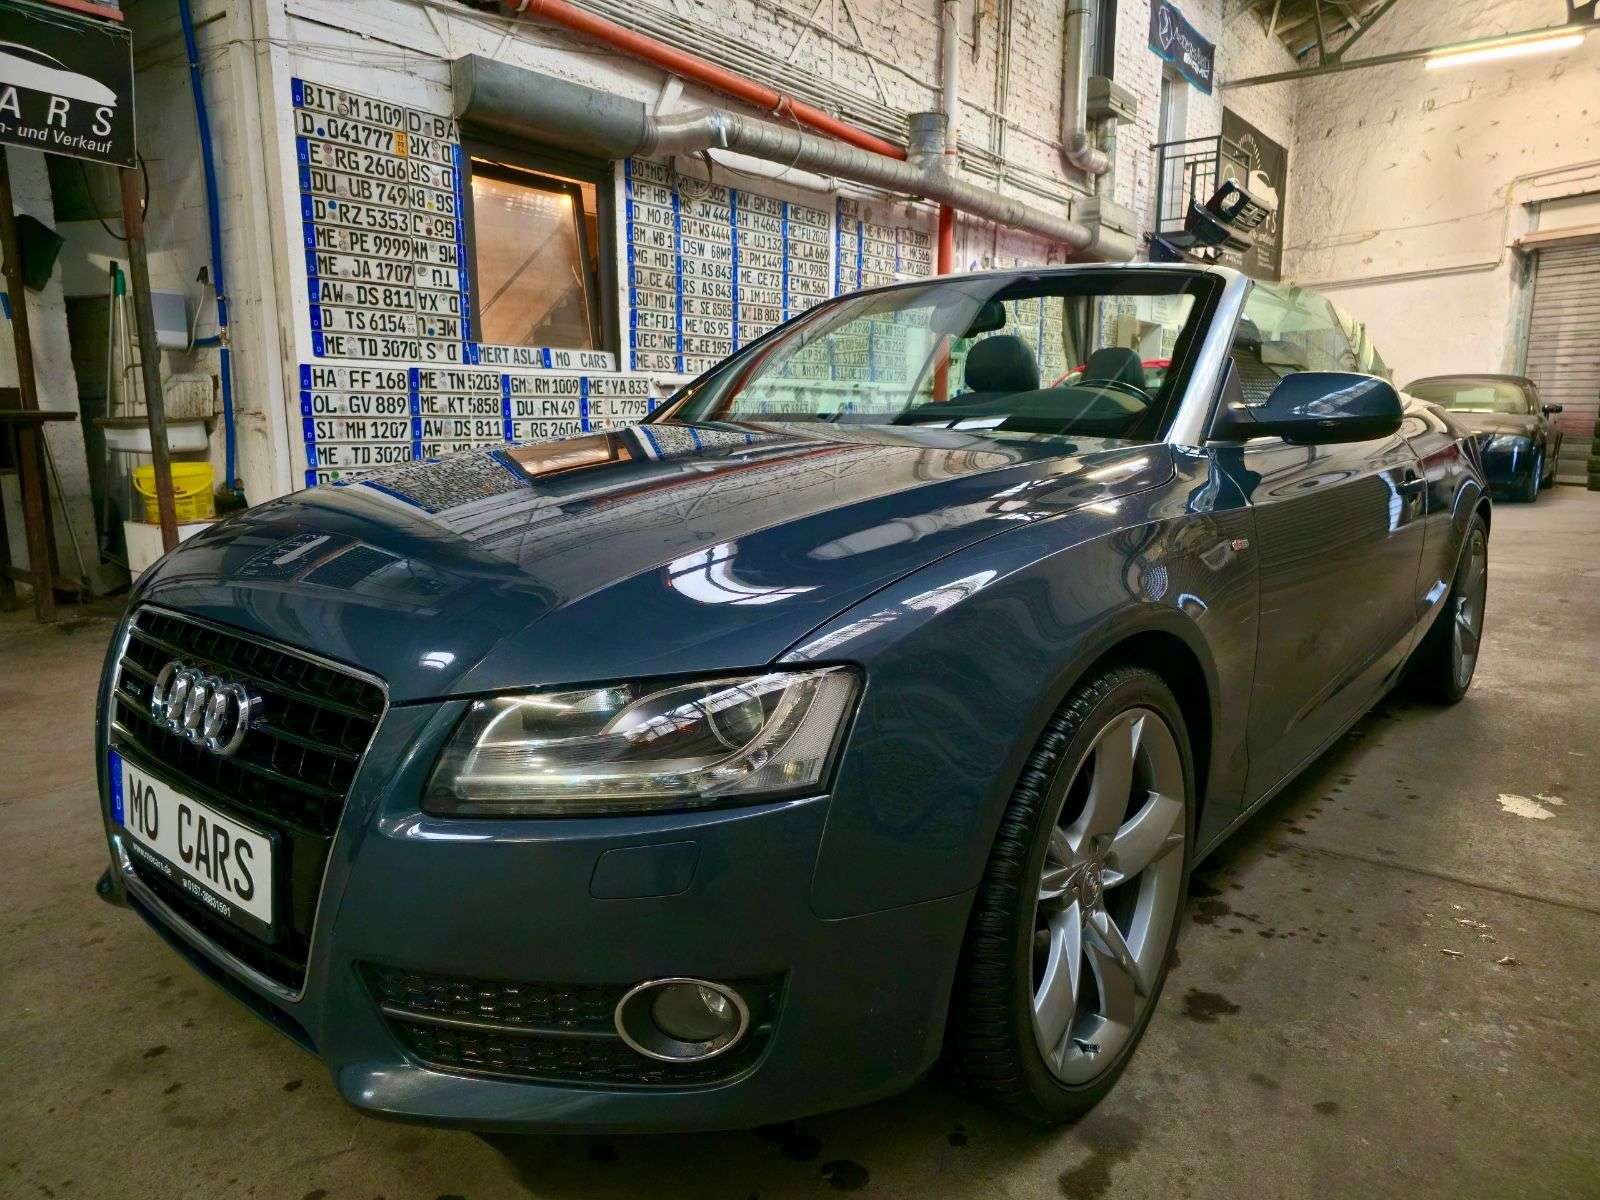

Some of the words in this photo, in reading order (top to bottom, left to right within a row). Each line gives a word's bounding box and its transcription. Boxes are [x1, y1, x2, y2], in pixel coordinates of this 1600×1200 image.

[304, 85, 336, 111] BIT
[349, 97, 360, 117] M
[364, 101, 402, 127] 1109
[19, 125, 47, 141] und
[54, 129, 112, 153] Verkauf
[303, 112, 314, 134] D
[327, 119, 393, 151] 041777
[309, 142, 322, 164] E
[335, 149, 359, 171] RG
[364, 155, 406, 179] 2606
[312, 171, 336, 194] DU
[350, 179, 372, 202] UB
[376, 183, 409, 204] 749
[315, 199, 326, 219] D
[339, 204, 362, 225] RZ
[366, 208, 408, 232] 5353
[634, 204, 640, 219] D
[647, 208, 660, 223] MO
[682, 220, 692, 234] GV
[316, 227, 337, 248] ME
[349, 232, 370, 252] PE
[374, 235, 410, 258] 9999
[634, 227, 645, 243] BM
[653, 231, 664, 249] WB
[738, 232, 748, 246] ME
[634, 249, 647, 264] MG
[655, 252, 668, 267] HD
[318, 255, 338, 276] ME
[352, 259, 371, 279] JA
[376, 262, 413, 283] 1707
[683, 261, 695, 275] RS
[701, 263, 713, 278] AS
[716, 264, 732, 279] 843
[636, 270, 642, 284] D
[650, 273, 662, 287] CE
[741, 271, 752, 283] ME
[758, 272, 768, 286] CE
[770, 274, 779, 287] 73
[321, 282, 343, 302] AW
[356, 286, 379, 306] DS
[383, 289, 414, 308] 811
[683, 280, 695, 294] RS
[702, 282, 713, 296] AS
[716, 283, 732, 298] 843
[637, 292, 648, 307] SU
[684, 300, 694, 313] ME
[701, 301, 710, 315] SE
[323, 309, 333, 328] D
[345, 310, 365, 330] TS
[370, 312, 406, 333] 6154
[638, 313, 649, 327] ME
[686, 319, 697, 333] ME
[704, 321, 716, 334] QS
[718, 322, 729, 336] 95
[325, 336, 346, 355] ME
[358, 338, 378, 356] TD
[382, 340, 418, 359] 3070
[637, 334, 656, 348] VEC
[684, 339, 694, 352] ME
[700, 340, 710, 353] EE
[478, 346, 509, 363] MERT
[555, 352, 570, 366] MO
[581, 352, 607, 369] CARS
[637, 354, 650, 368] ME
[657, 355, 670, 369] BS
[313, 369, 337, 388] HA
[350, 371, 372, 388] FF
[376, 372, 406, 390] 168
[420, 372, 437, 388] ME
[448, 373, 465, 389] TN
[468, 374, 499, 391] 5203
[511, 378, 526, 392] GM
[535, 378, 549, 393] RM
[552, 378, 579, 394] 1009
[589, 379, 604, 394] ME
[612, 381, 626, 394] YA
[629, 380, 649, 394] 833
[313, 395, 337, 413] OL
[350, 396, 372, 413] GV
[376, 397, 407, 414] 889
[421, 397, 439, 412] ME
[448, 397, 465, 413] KT
[468, 398, 499, 414] 5858
[517, 401, 533, 415] DU
[542, 402, 560, 416] FN
[561, 401, 575, 415] 49
[589, 401, 604, 414] ME
[610, 401, 618, 414] L
[621, 401, 647, 415] 7795
[317, 421, 335, 439] SI
[346, 422, 366, 439] MH
[370, 421, 408, 439] 1207
[424, 422, 443, 436] AW
[454, 420, 471, 436] DS
[475, 420, 501, 437] 811
[514, 423, 522, 438] E
[531, 423, 548, 438] RG
[318, 447, 338, 465] ME
[352, 448, 370, 464] TD
[375, 447, 410, 463] 3020
[130, 773, 158, 840] MO
[178, 804, 254, 901] CARS
